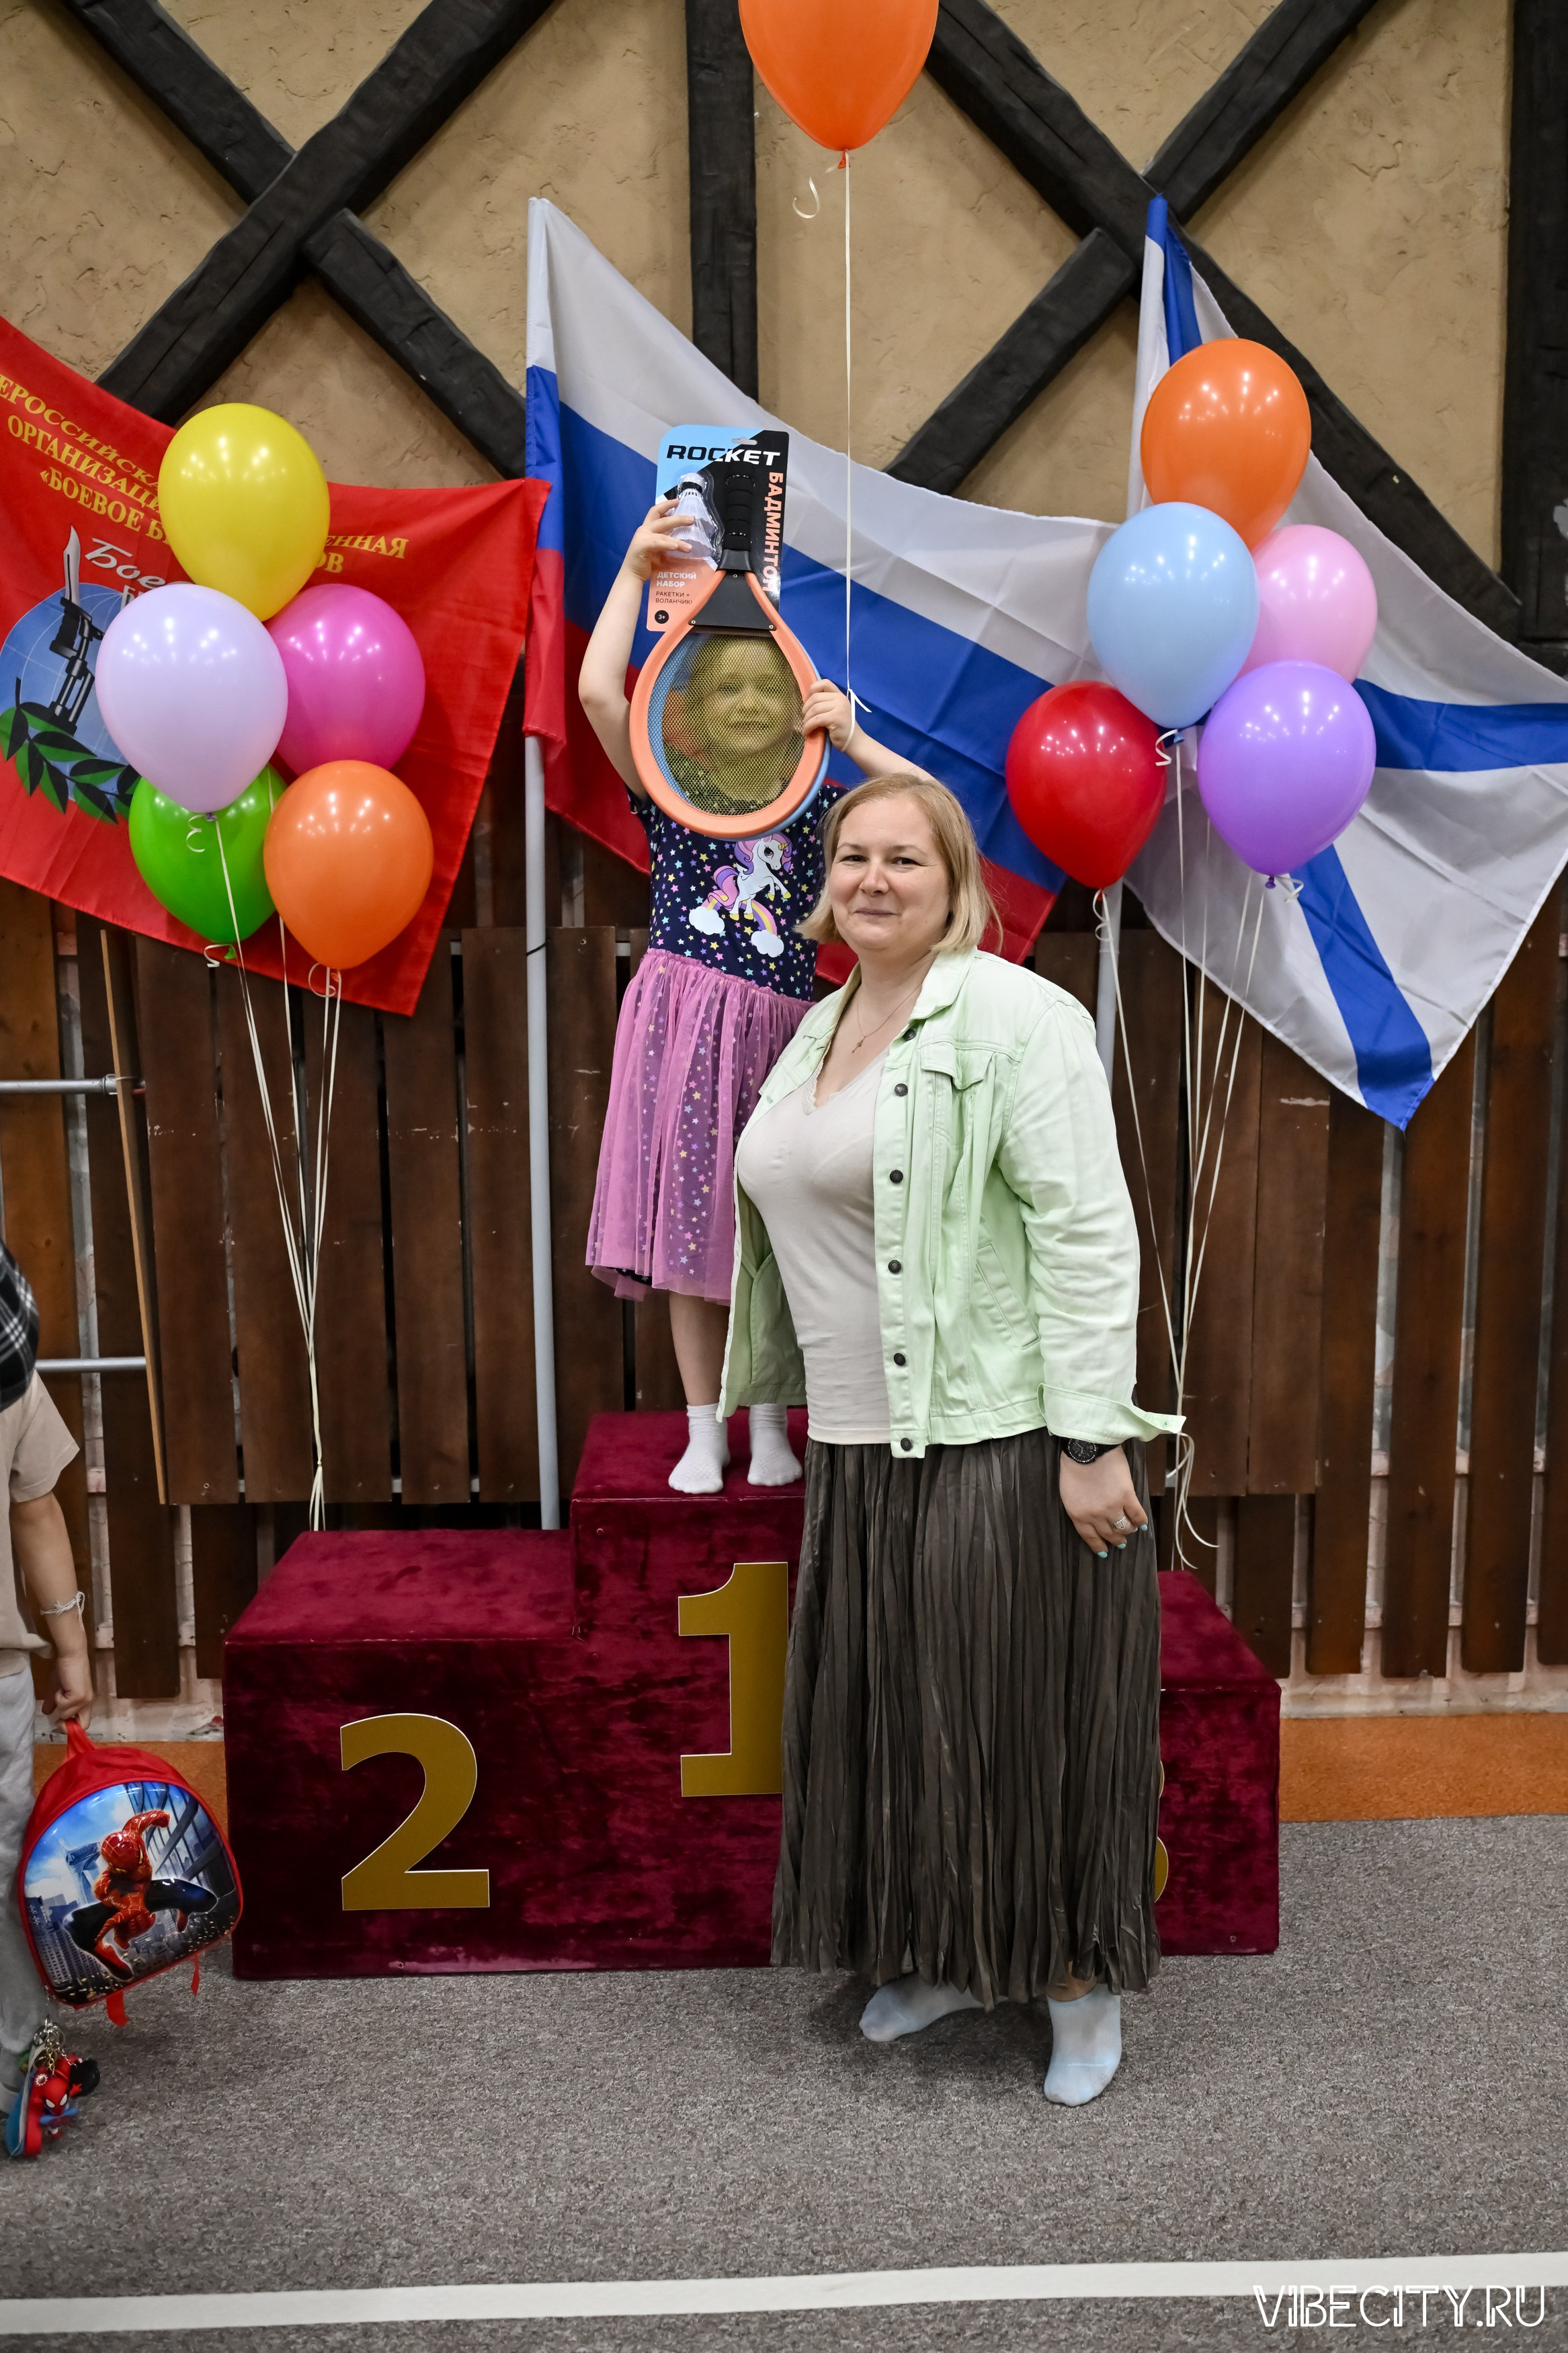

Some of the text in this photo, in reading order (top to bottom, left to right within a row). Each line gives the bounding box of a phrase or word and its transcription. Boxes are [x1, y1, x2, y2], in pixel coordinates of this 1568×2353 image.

[39, 467, 144, 532] «БОЕВОЕ
[667, 445, 780, 466] ROCKET
[657, 571, 696, 580] ДЕТСКИЙ
[762, 472, 784, 591] БАДМИНТОН
[678, 1562, 788, 1797] 1
[340, 1713, 490, 1910] 2
